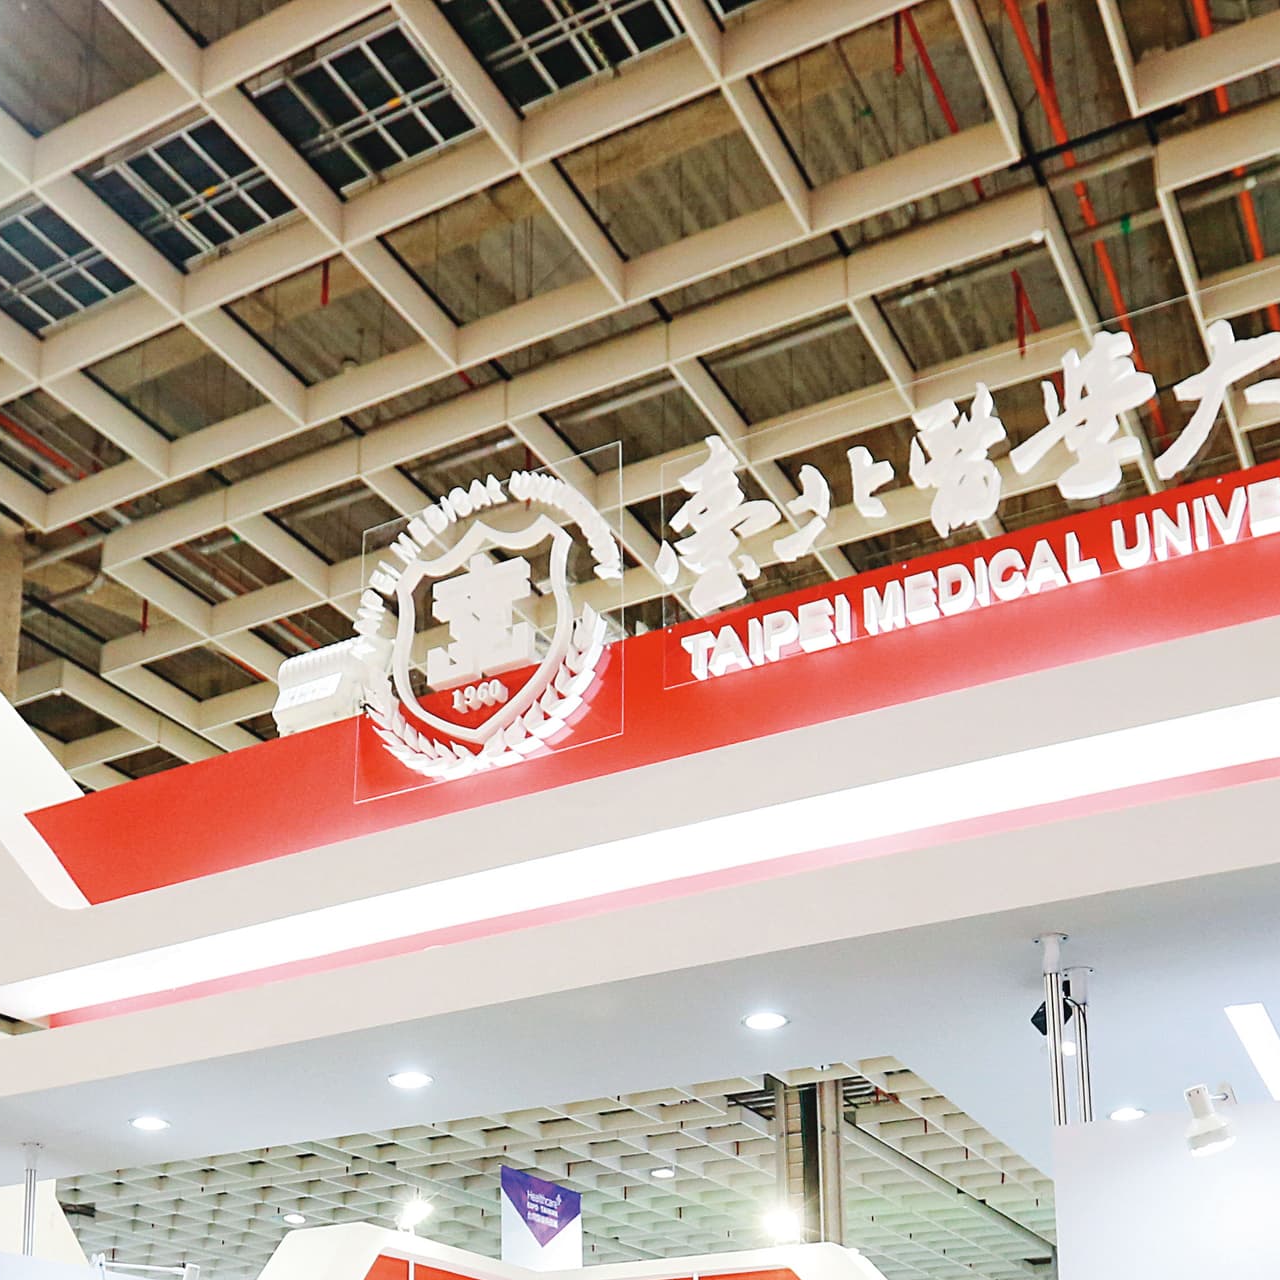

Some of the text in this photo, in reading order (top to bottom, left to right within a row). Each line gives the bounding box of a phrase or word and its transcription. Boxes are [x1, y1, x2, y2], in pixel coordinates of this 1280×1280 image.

[681, 594, 851, 681] TAIPEI
[863, 532, 1101, 636] MEDICAL
[452, 679, 509, 713] 1960
